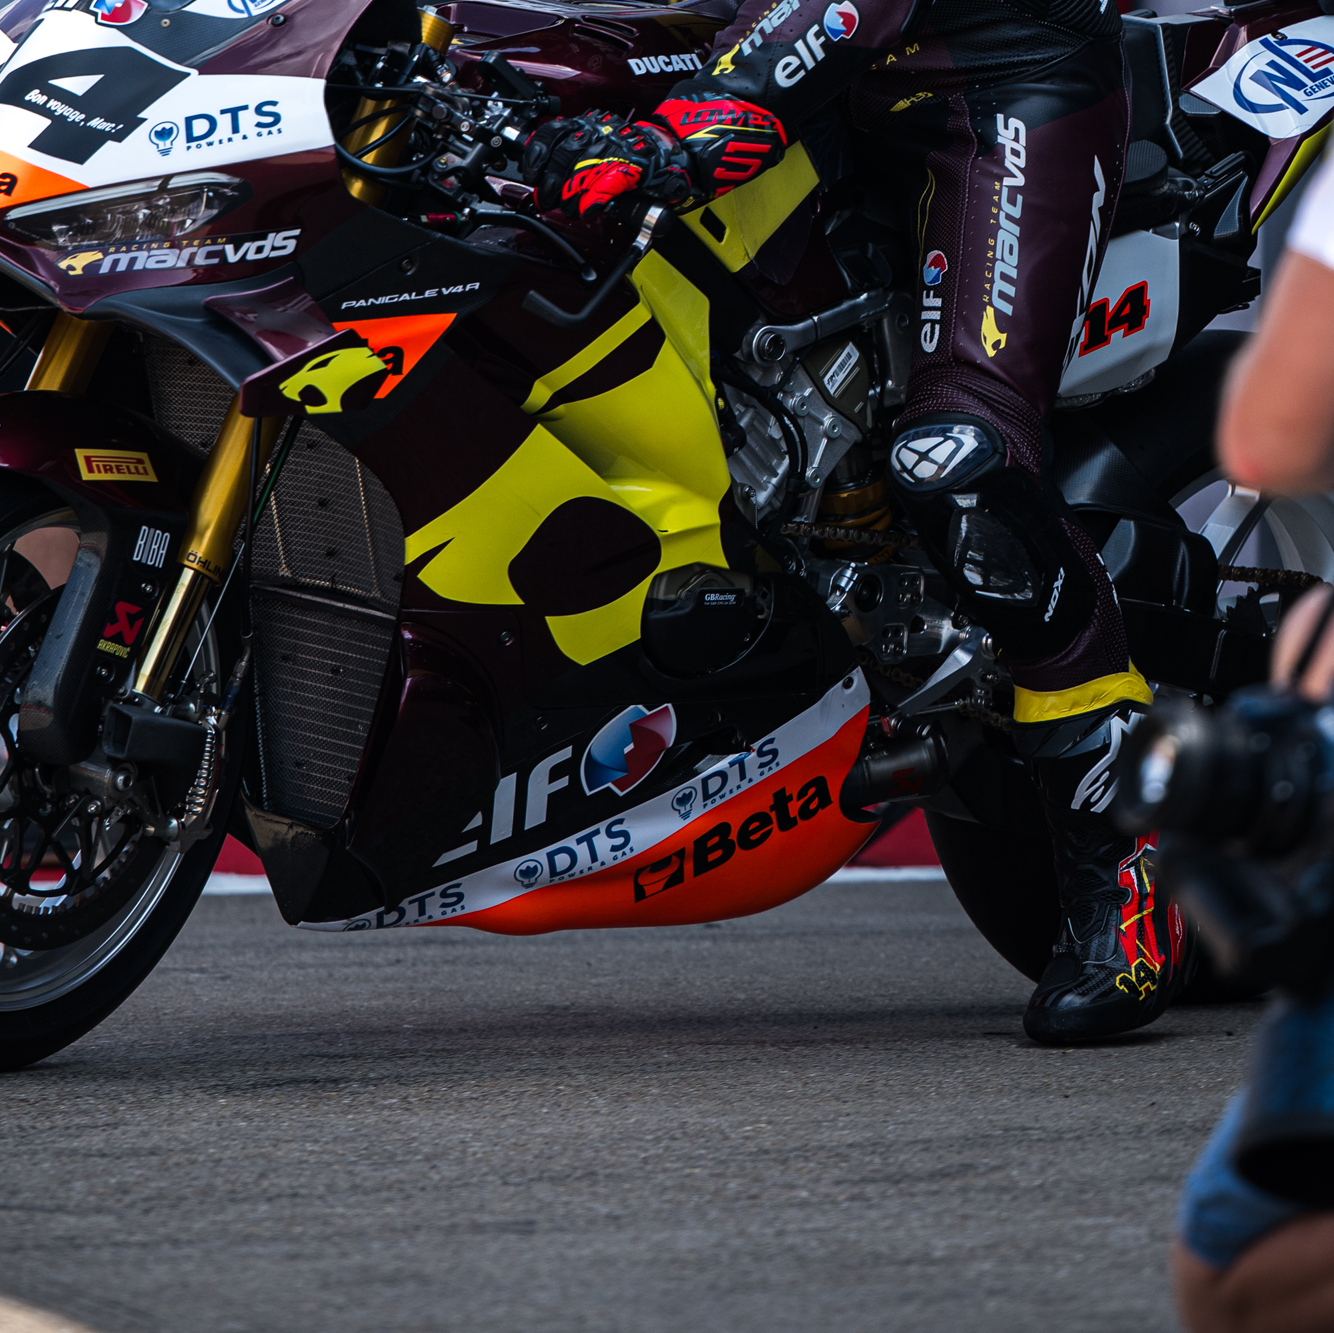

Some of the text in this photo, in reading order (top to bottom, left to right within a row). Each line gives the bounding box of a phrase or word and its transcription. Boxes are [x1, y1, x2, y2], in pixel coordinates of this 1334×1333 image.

[626, 52, 704, 76] DUCATI
[774, 24, 827, 88] elf
[23, 88, 125, 134] Bon voyage, Marc!
[183, 100, 282, 144] DTS
[185, 126, 284, 153] POWER & GAS
[108, 236, 228, 254] RACING TEAM
[981, 180, 1001, 303] RACING TEAM
[340, 288, 440, 311] PANIGALE
[920, 288, 943, 354] elf
[1078, 279, 1151, 359] 14
[83, 454, 150, 478] PIRELLI
[704, 592, 737, 602] GBRacing
[700, 736, 781, 804] DTS
[702, 760, 782, 811] POWER & GAS
[544, 817, 633, 879] DTS
[691, 775, 835, 878] Beta
[548, 845, 636, 884] POWER & GAS
[440, 903, 467, 917] GAS
